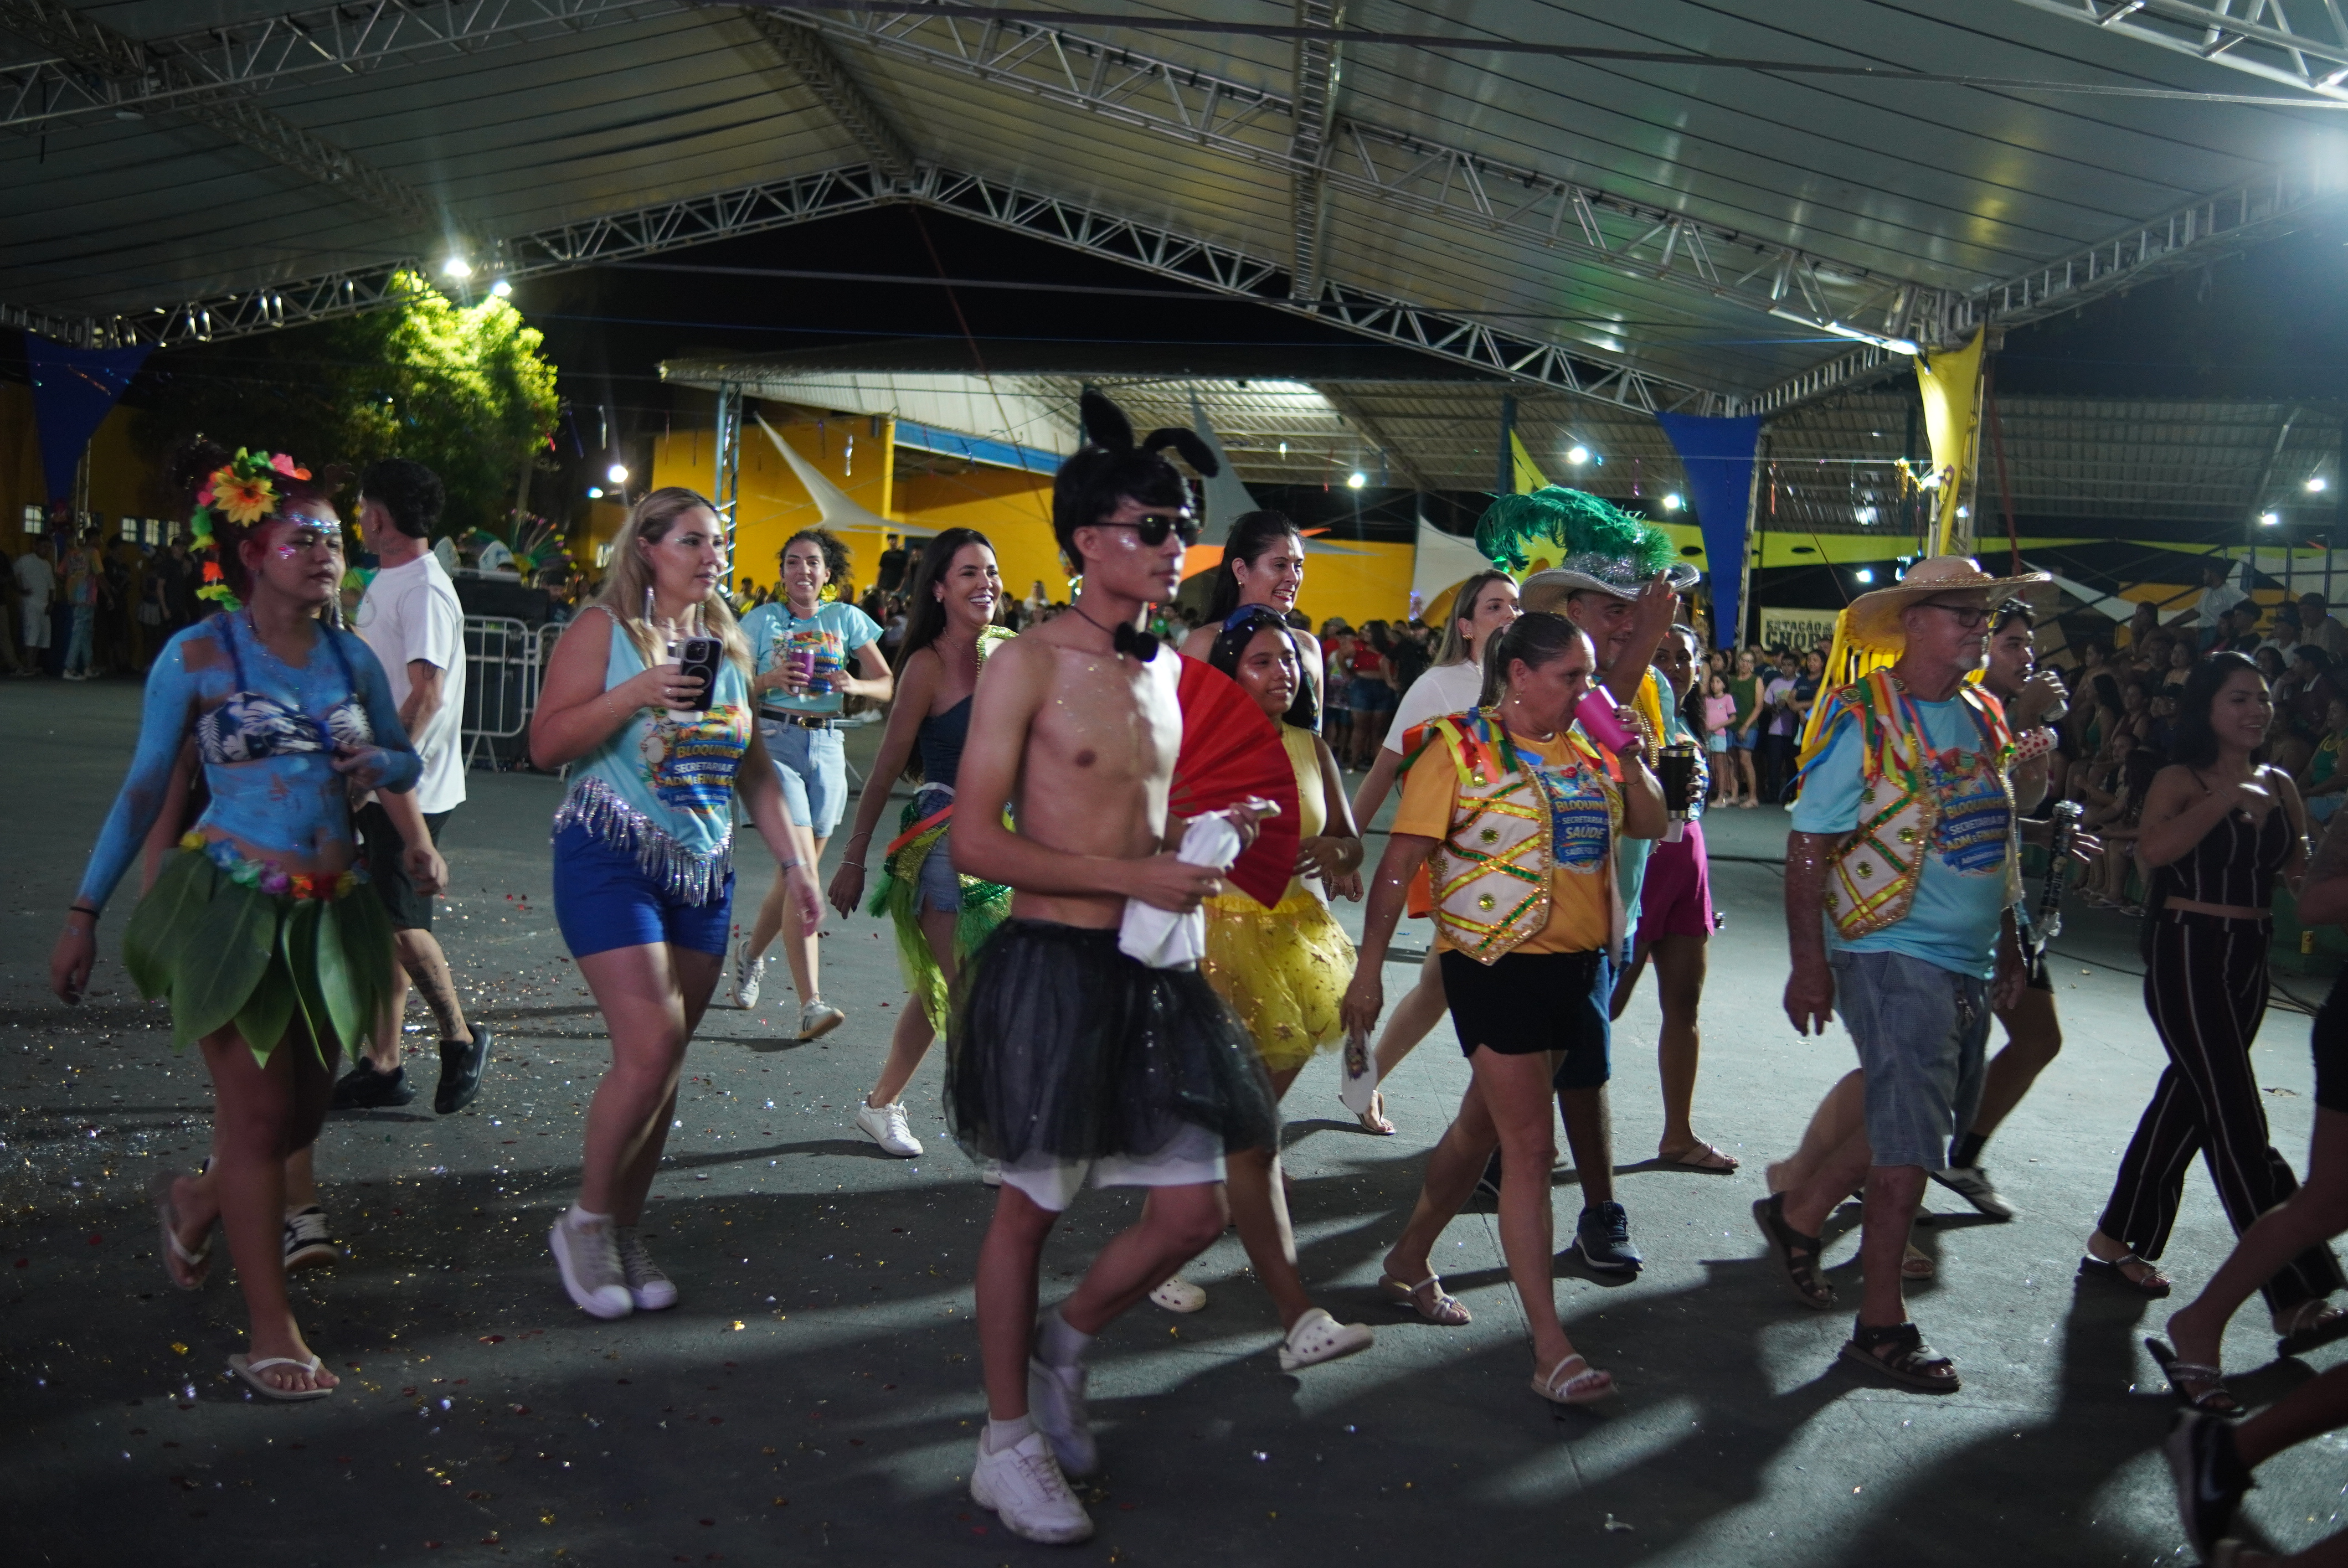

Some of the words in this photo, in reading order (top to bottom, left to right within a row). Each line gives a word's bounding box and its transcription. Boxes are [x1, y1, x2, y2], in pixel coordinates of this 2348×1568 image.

[1766, 618, 1821, 633] ESTAÇÃO
[1562, 816, 1603, 824] SECRETARIA
[1948, 817, 1995, 835] SECRETARIA
[1565, 824, 1606, 839] SAÚDE
[1946, 834, 1971, 849] ADM
